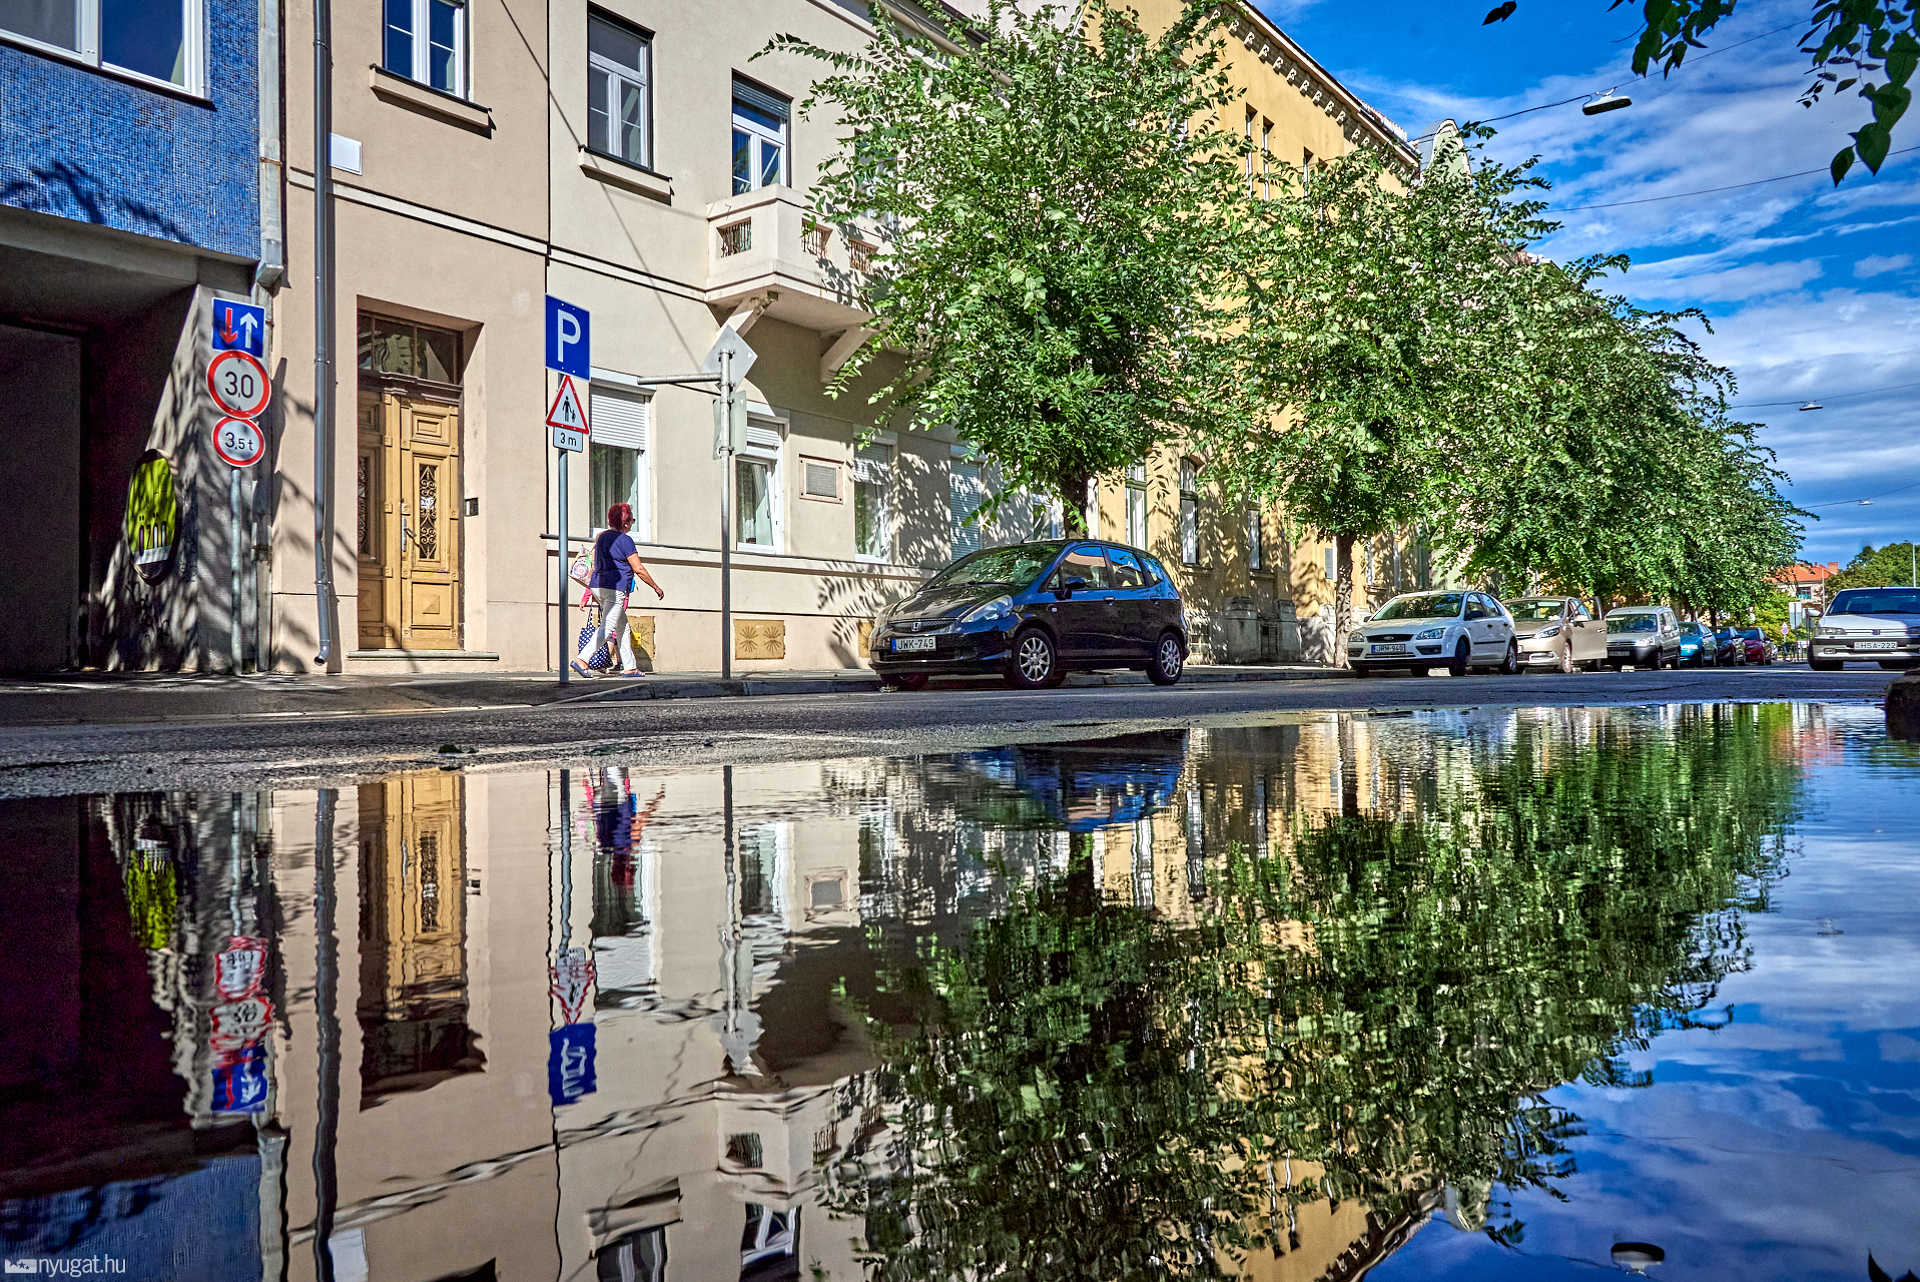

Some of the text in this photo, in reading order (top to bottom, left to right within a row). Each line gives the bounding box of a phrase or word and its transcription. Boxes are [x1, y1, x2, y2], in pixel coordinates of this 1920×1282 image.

[557, 308, 581, 363] P
[560, 432, 577, 447] 3 m
[898, 638, 934, 650] JWK-749
